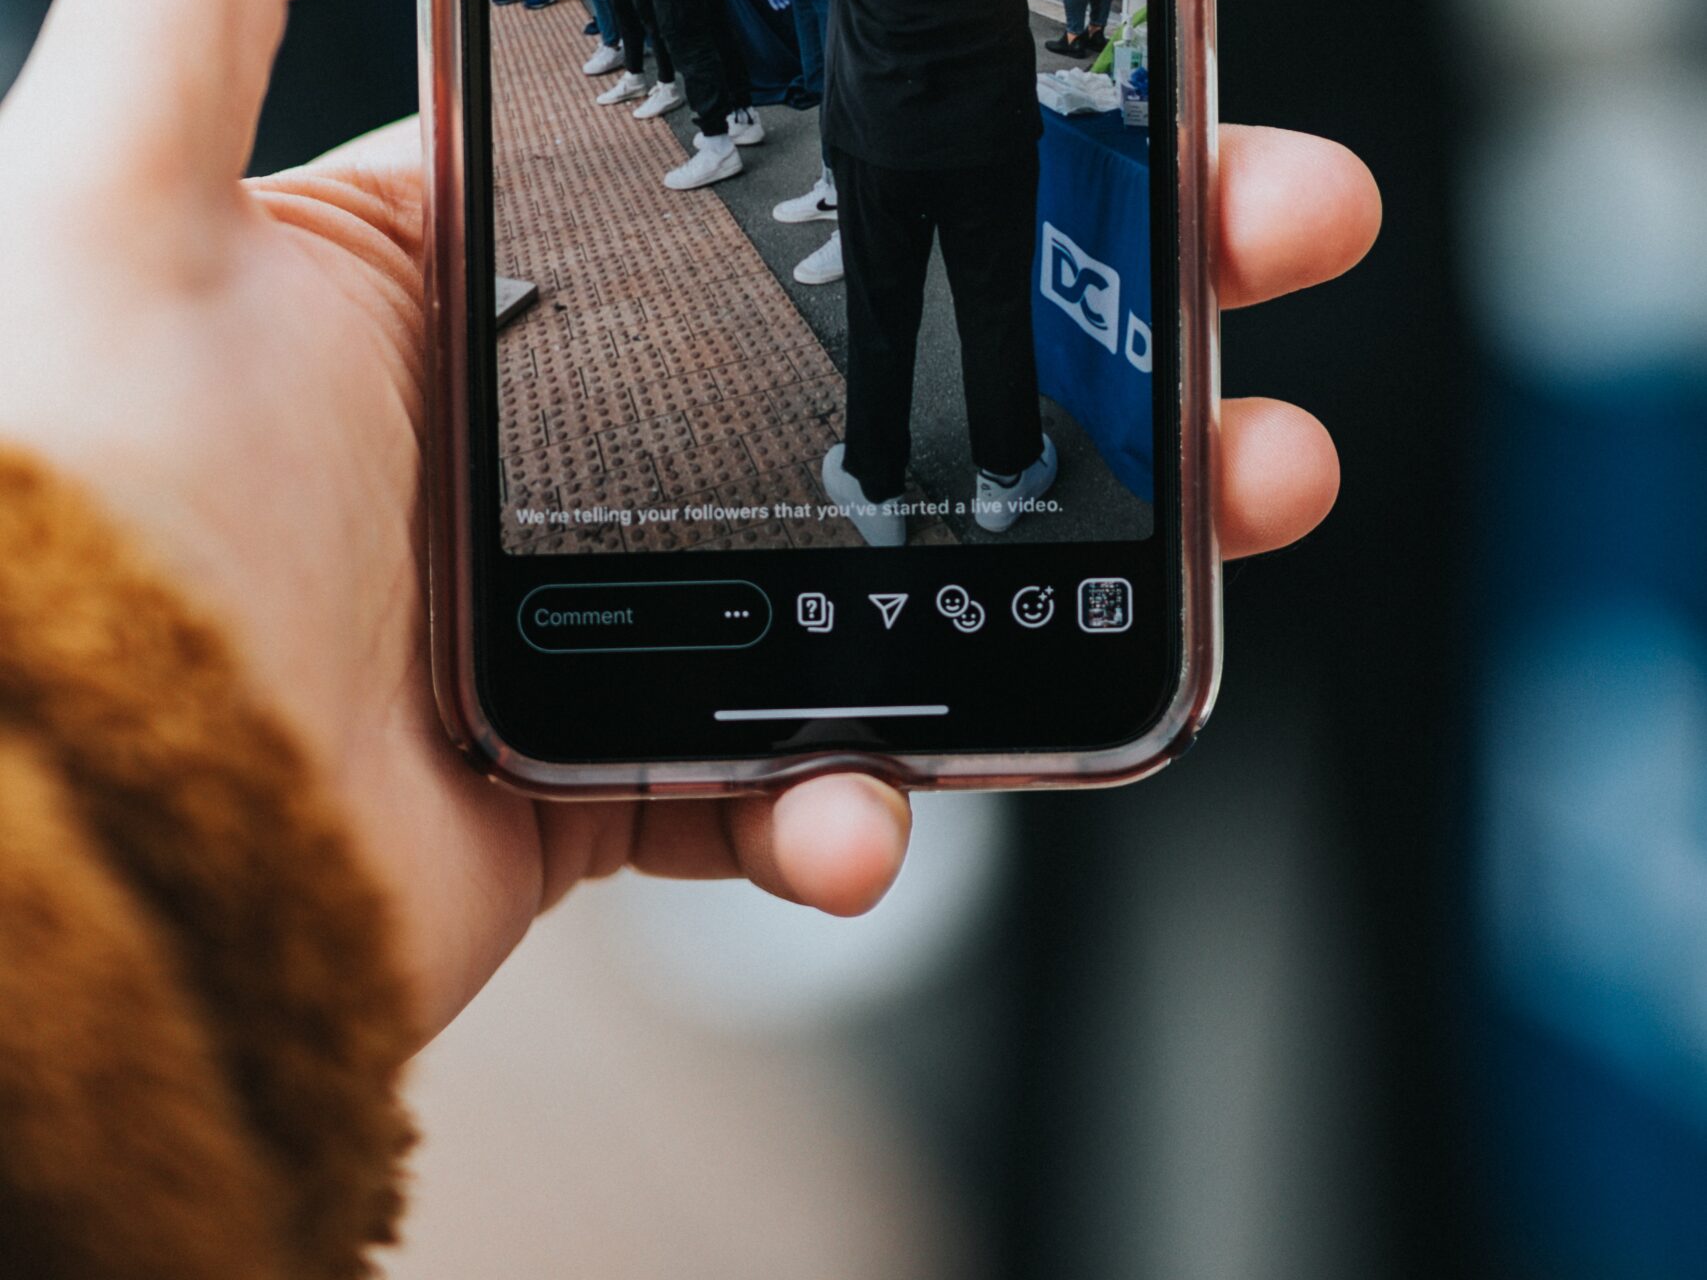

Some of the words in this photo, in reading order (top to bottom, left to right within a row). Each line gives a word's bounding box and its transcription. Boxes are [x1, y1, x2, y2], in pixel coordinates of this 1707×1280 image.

[516, 508, 569, 524] We're
[574, 506, 632, 526] telling
[637, 507, 680, 525] your
[684, 504, 769, 521] followers
[773, 502, 811, 518] that
[816, 502, 877, 521] you've
[882, 499, 950, 516] started
[955, 502, 966, 515] a
[971, 498, 1003, 514] live
[1007, 496, 1064, 513] video.
[534, 606, 634, 627] Comment
